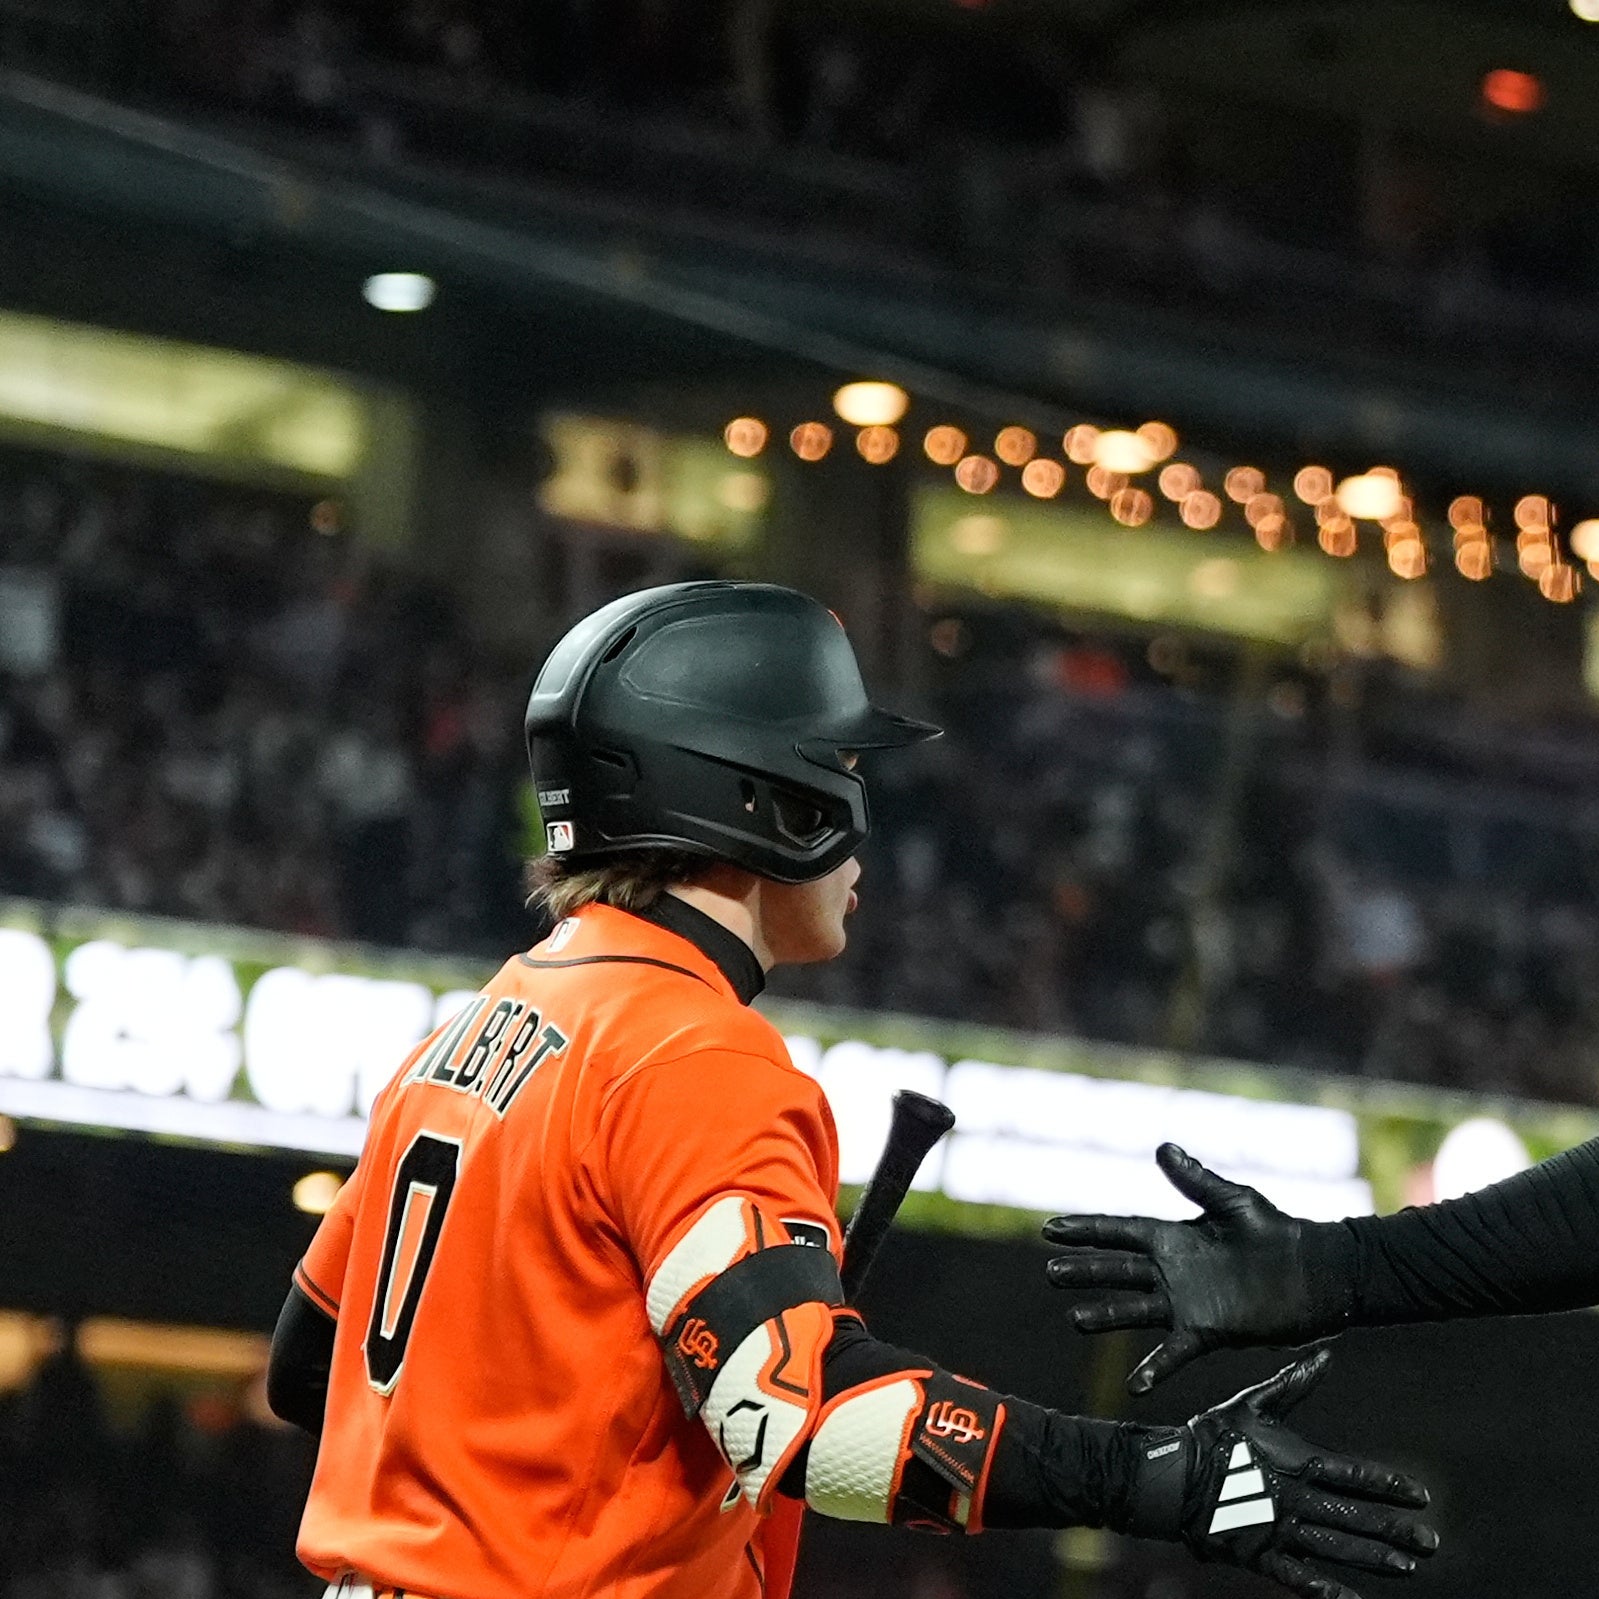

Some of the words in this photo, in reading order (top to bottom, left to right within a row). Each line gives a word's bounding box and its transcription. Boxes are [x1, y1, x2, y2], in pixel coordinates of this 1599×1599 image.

[363, 1129, 464, 1397] 0
[677, 1317, 720, 1371] SF
[925, 1401, 986, 1444] SF
